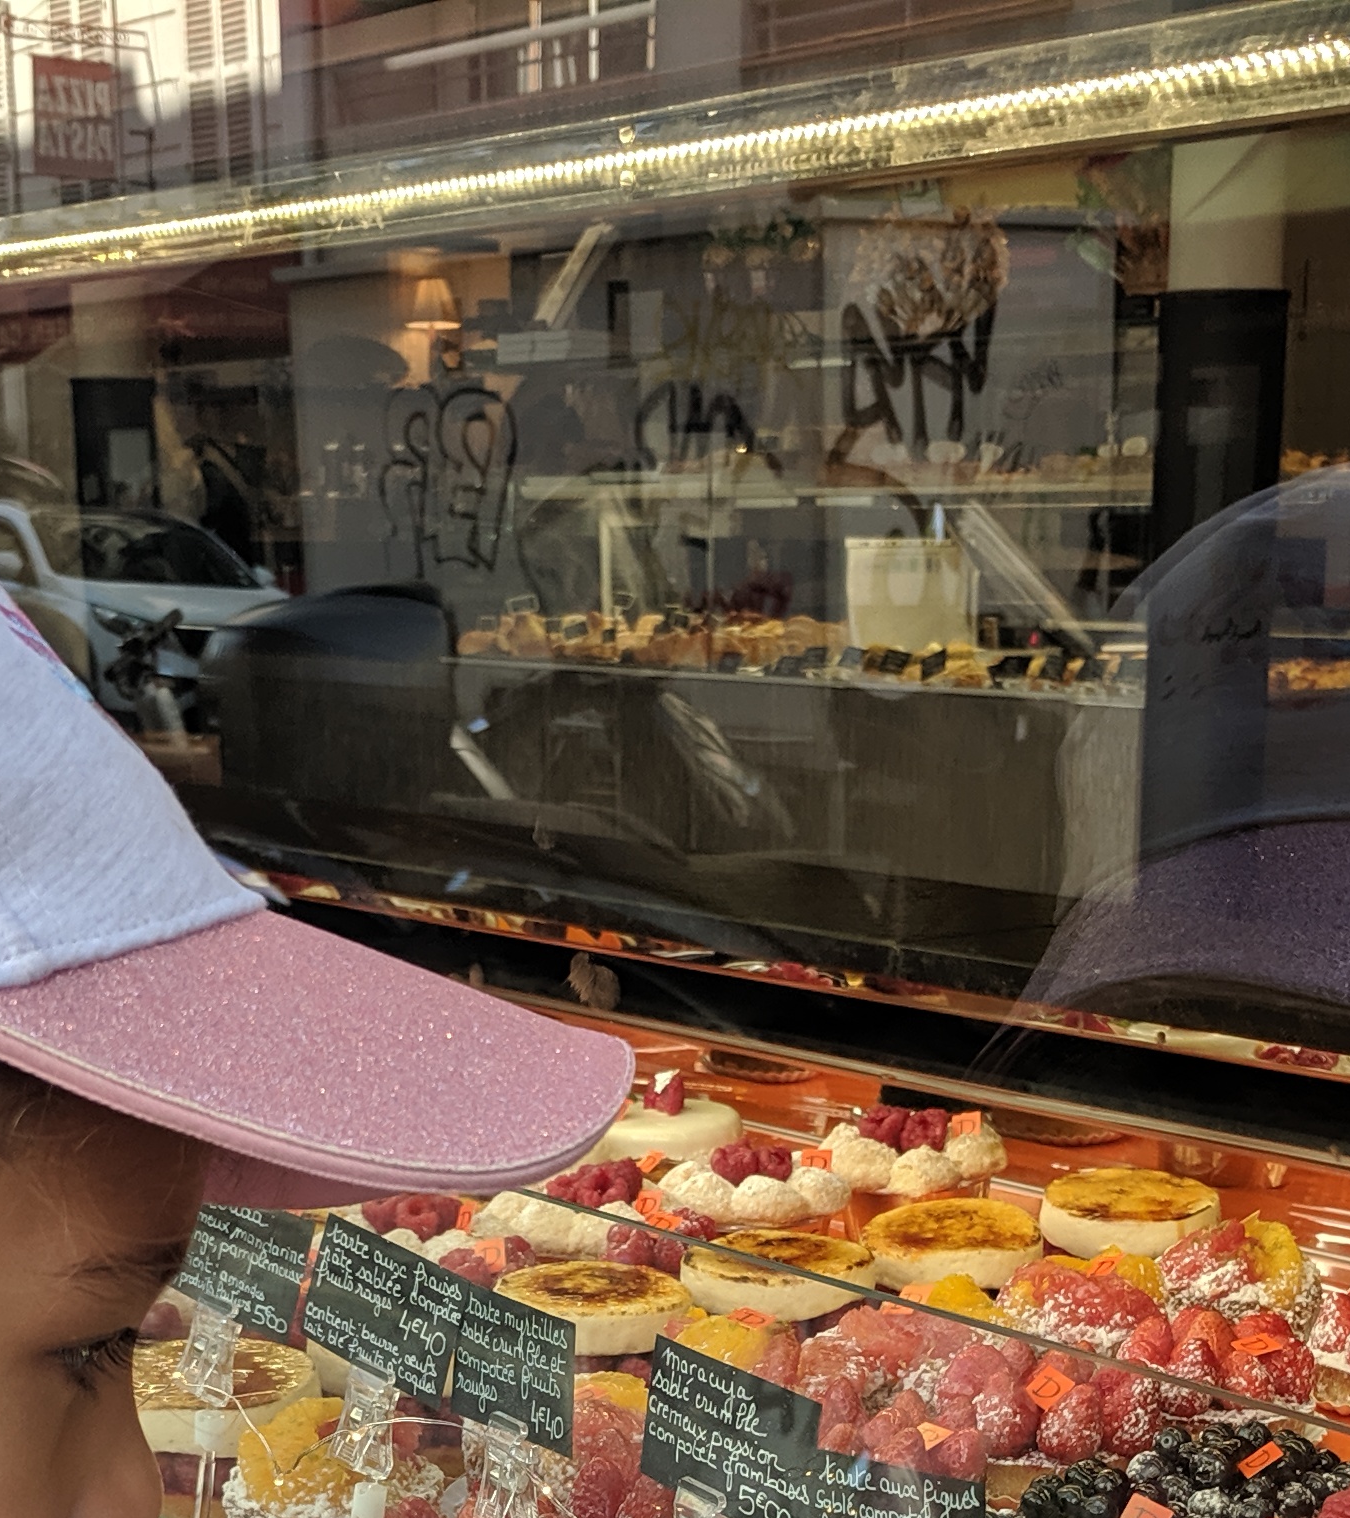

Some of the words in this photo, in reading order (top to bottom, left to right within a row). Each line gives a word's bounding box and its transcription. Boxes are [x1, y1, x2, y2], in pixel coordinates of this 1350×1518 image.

[326, 1223, 369, 1259] tarte
[373, 1250, 407, 1279] aux
[413, 1262, 462, 1301] fraises
[482, 1247, 502, 1266] D
[1095, 1260, 1115, 1275] D
[316, 1260, 354, 1288] fruits
[464, 1291, 501, 1325] tarte
[504, 1311, 568, 1350] myrtilles
[736, 1312, 765, 1324] D
[461, 1320, 493, 1349] sablé
[550, 1353, 566, 1375] et
[1241, 1338, 1268, 1349] D
[455, 1371, 497, 1414] rouges
[520, 1365, 561, 1400] fruits
[652, 1369, 694, 1402] sablé
[661, 1346, 754, 1414] maracuja
[1032, 1376, 1061, 1398] D
[1245, 1450, 1270, 1468] D
[819, 1455, 876, 1491] tarte
[879, 1477, 920, 1500] aux
